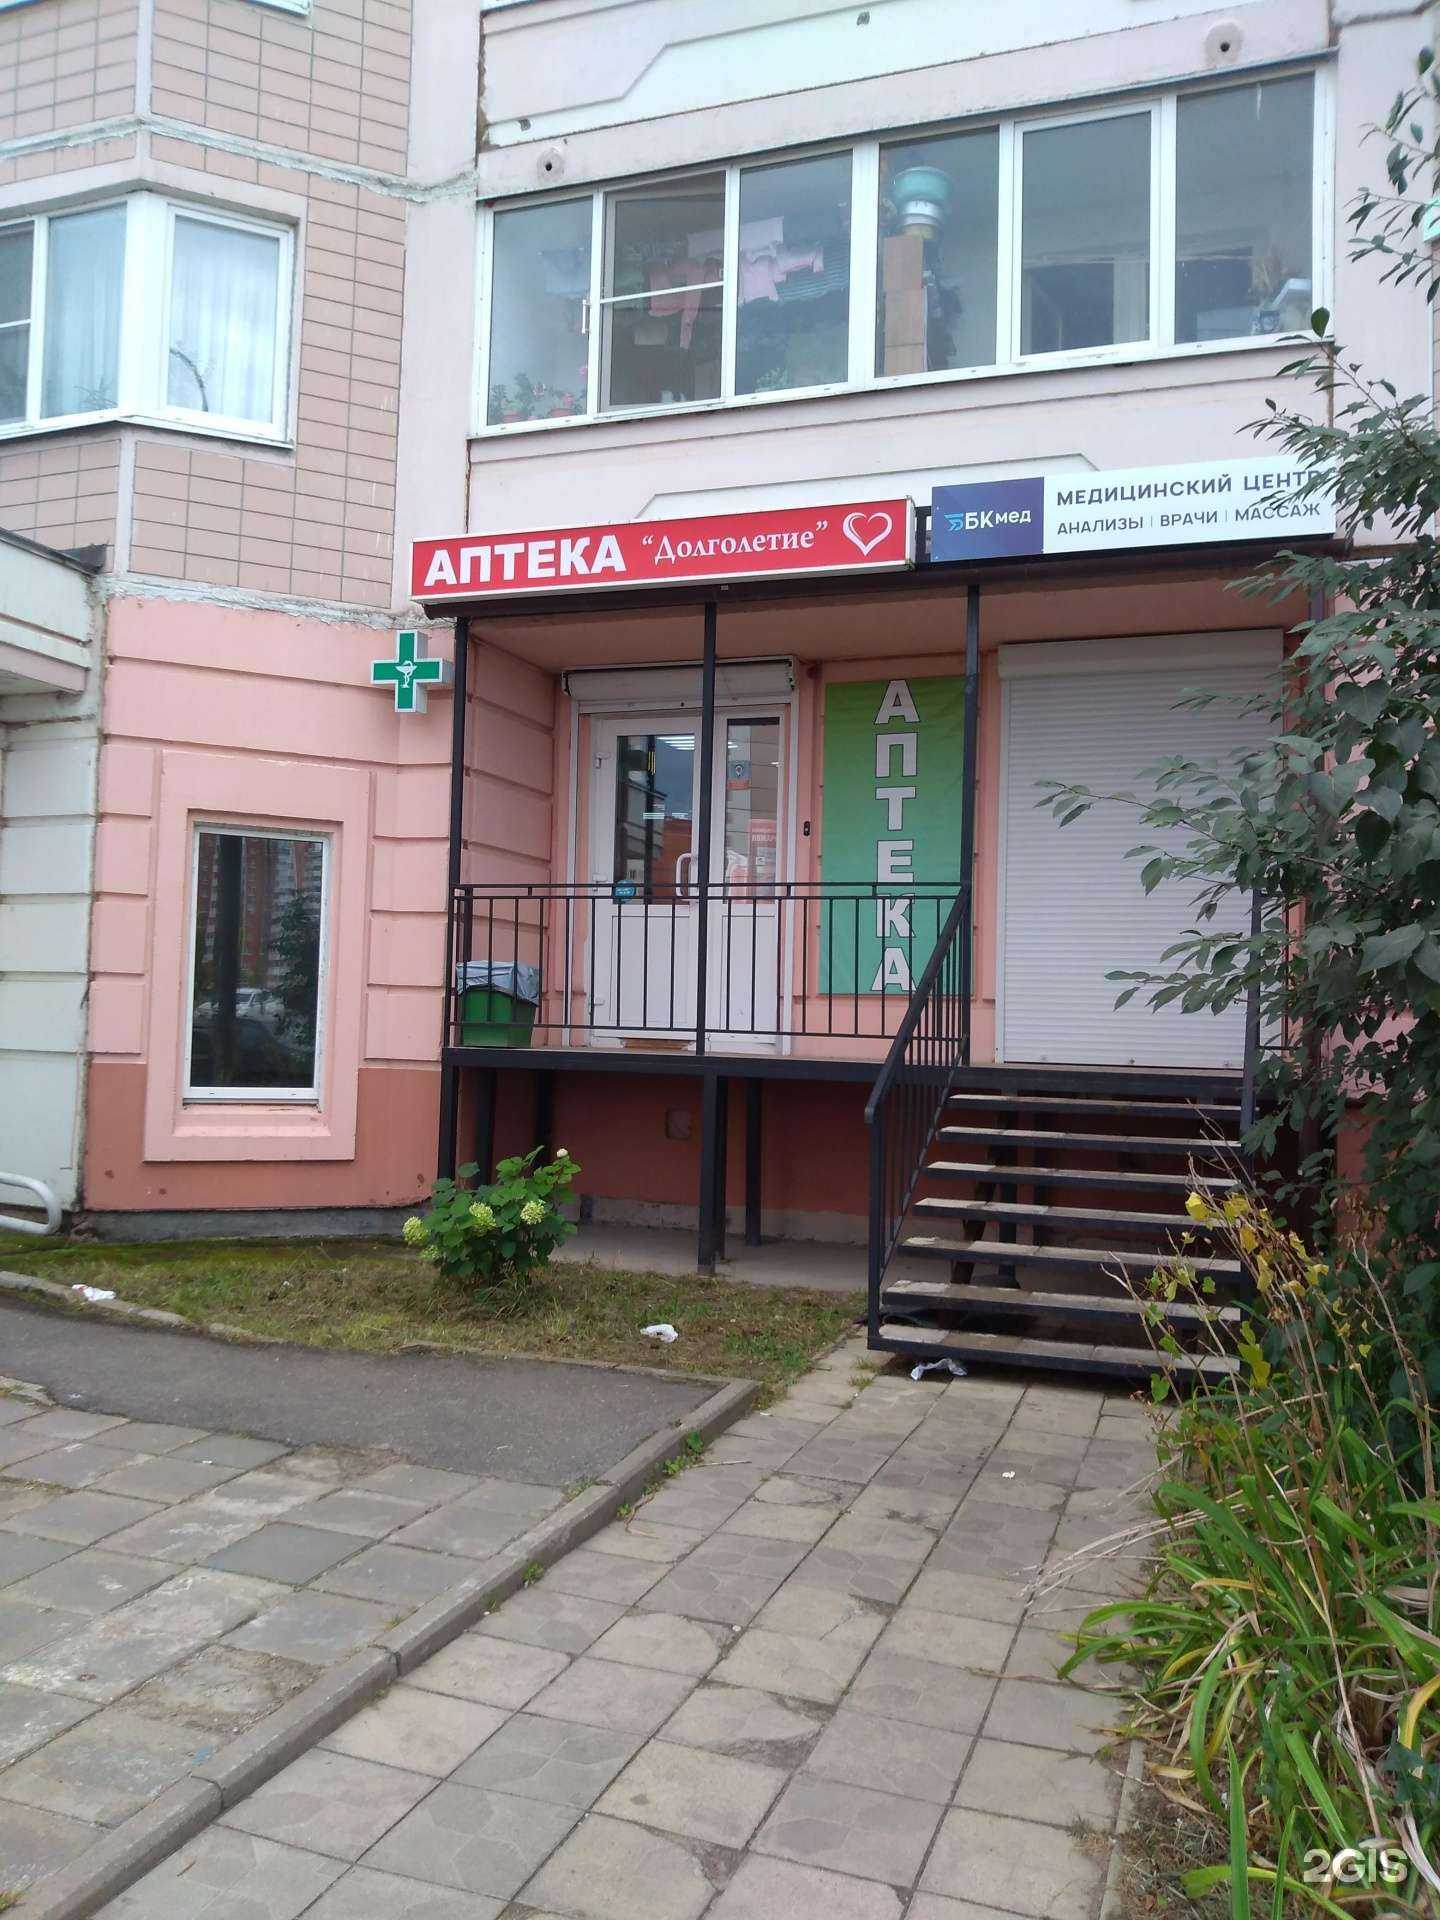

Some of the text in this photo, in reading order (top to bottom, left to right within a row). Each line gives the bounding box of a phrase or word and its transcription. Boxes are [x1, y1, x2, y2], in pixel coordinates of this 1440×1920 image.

[1056, 473, 1232, 507] МЕДИЦИНСКИЙ
[1057, 503, 1320, 536] АНАЛИЗЫ ВРАЧИ МАССАЖ
[424, 534, 626, 587] АПТЕКА
[870, 679, 920, 992] АПТЕКА
